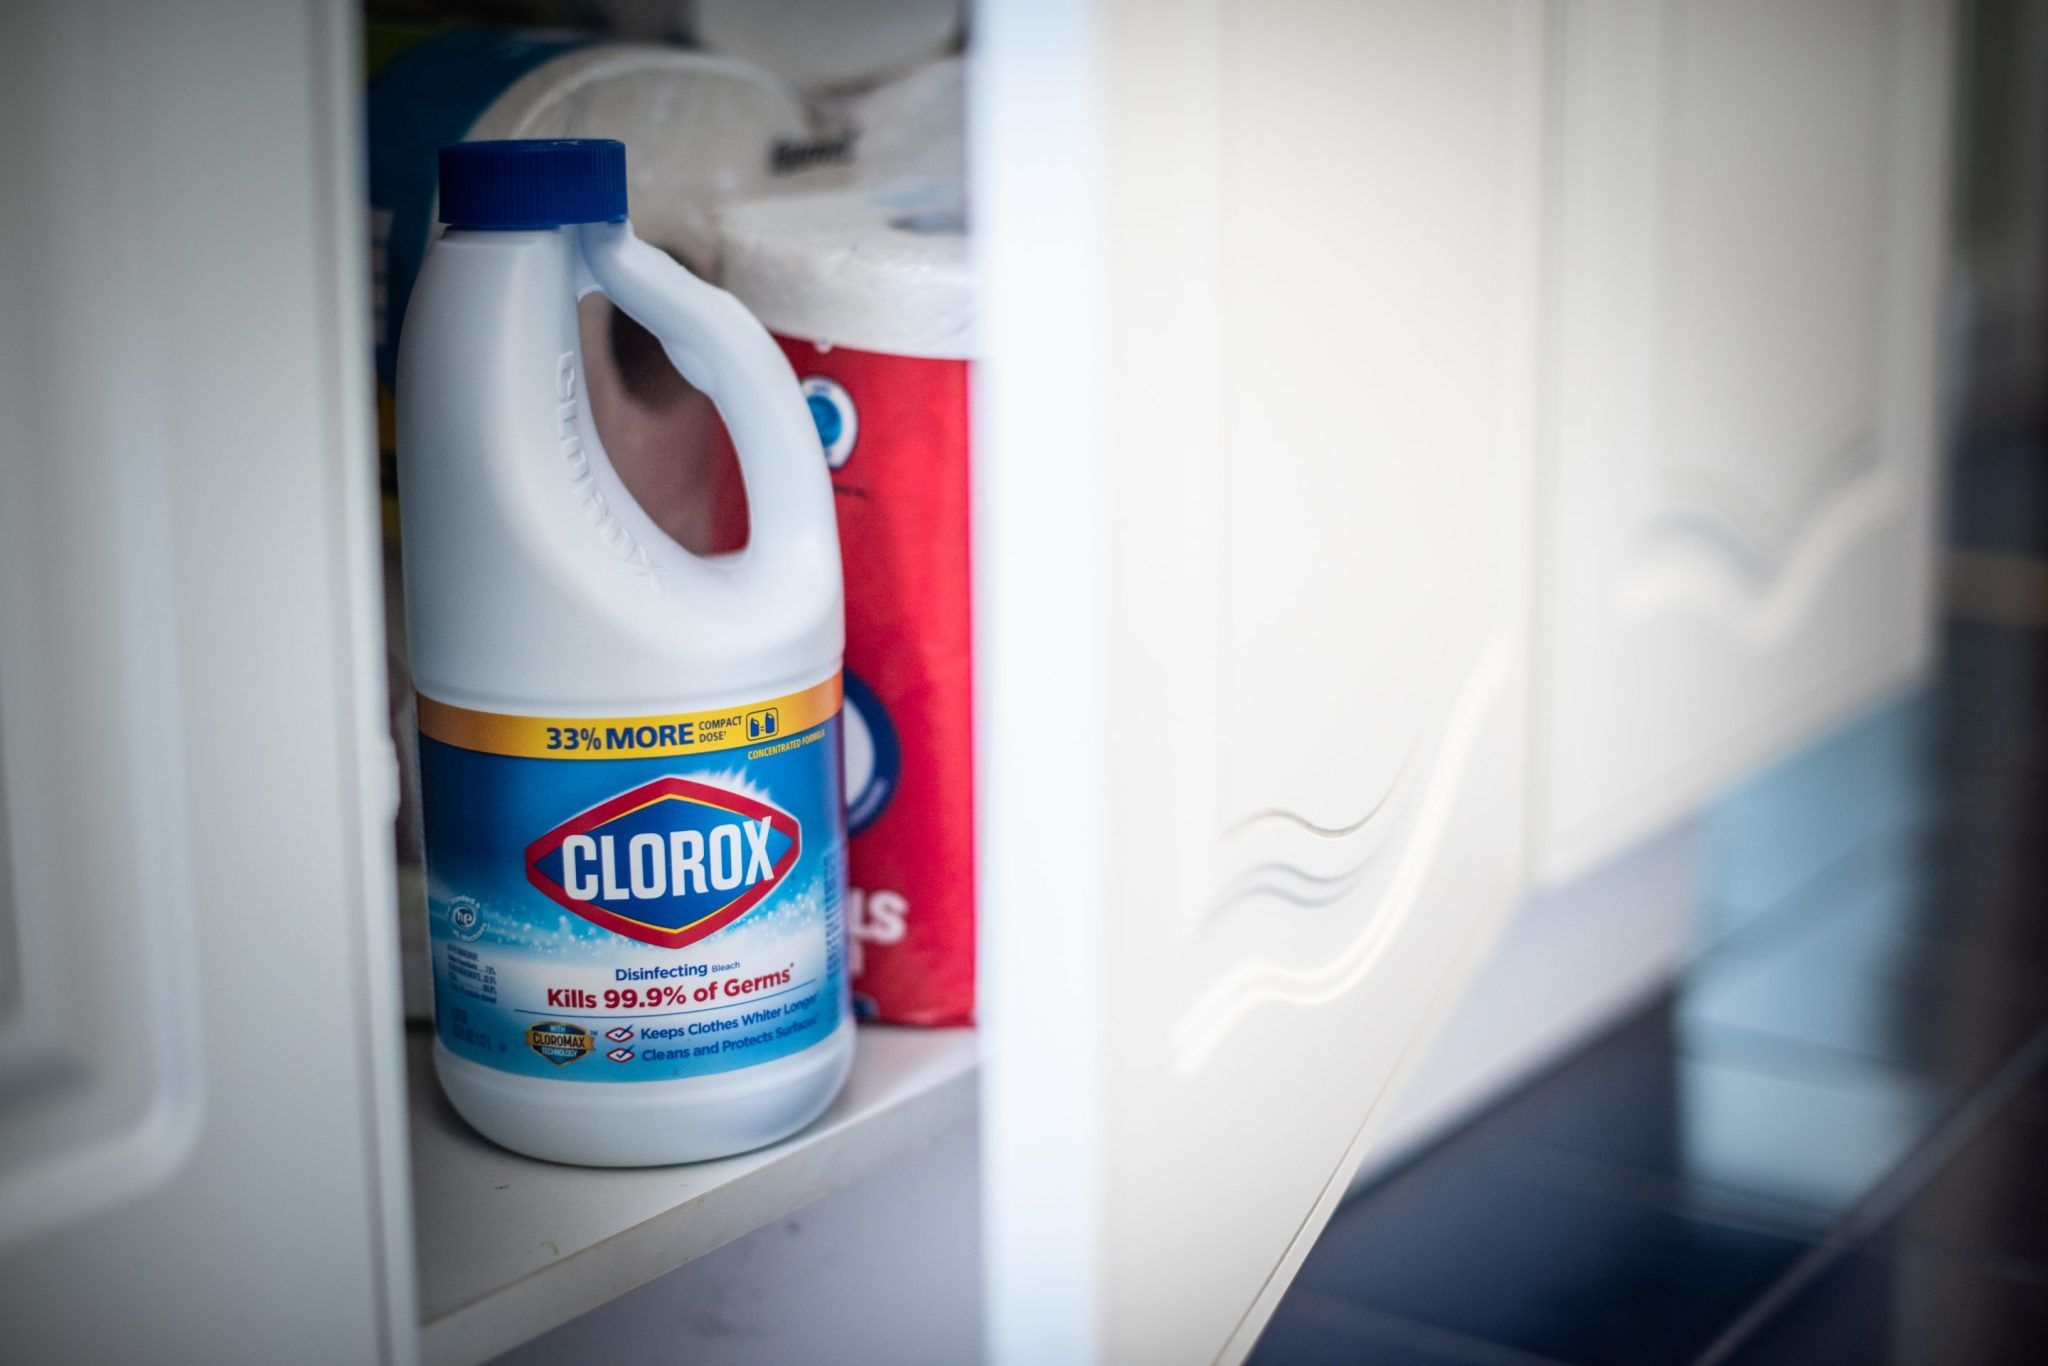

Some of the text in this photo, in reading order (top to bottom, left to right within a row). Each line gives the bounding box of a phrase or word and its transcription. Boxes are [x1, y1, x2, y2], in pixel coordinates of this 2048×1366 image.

[557, 351, 665, 595] CLOROX
[546, 722, 695, 751] 33% MORE
[698, 715, 742, 731] COMPACT
[747, 738, 802, 760] CONCENTRATED
[562, 815, 775, 901] CLOROX
[615, 961, 741, 981] Disinfecting Bleach
[547, 988, 598, 1009] Kills
[603, 985, 687, 1009] 99.9%
[693, 981, 718, 1002] of
[640, 1027, 685, 1040] Keeps
[688, 1018, 739, 1036] Clothes
[741, 1007, 782, 1026] Whiter
[532, 1032, 585, 1048] CLOROMAX
[541, 1047, 578, 1057] TECHNOLOGY
[641, 1049, 691, 1062] Cleans
[693, 1041, 719, 1056] and
[722, 1031, 774, 1052] Protects
